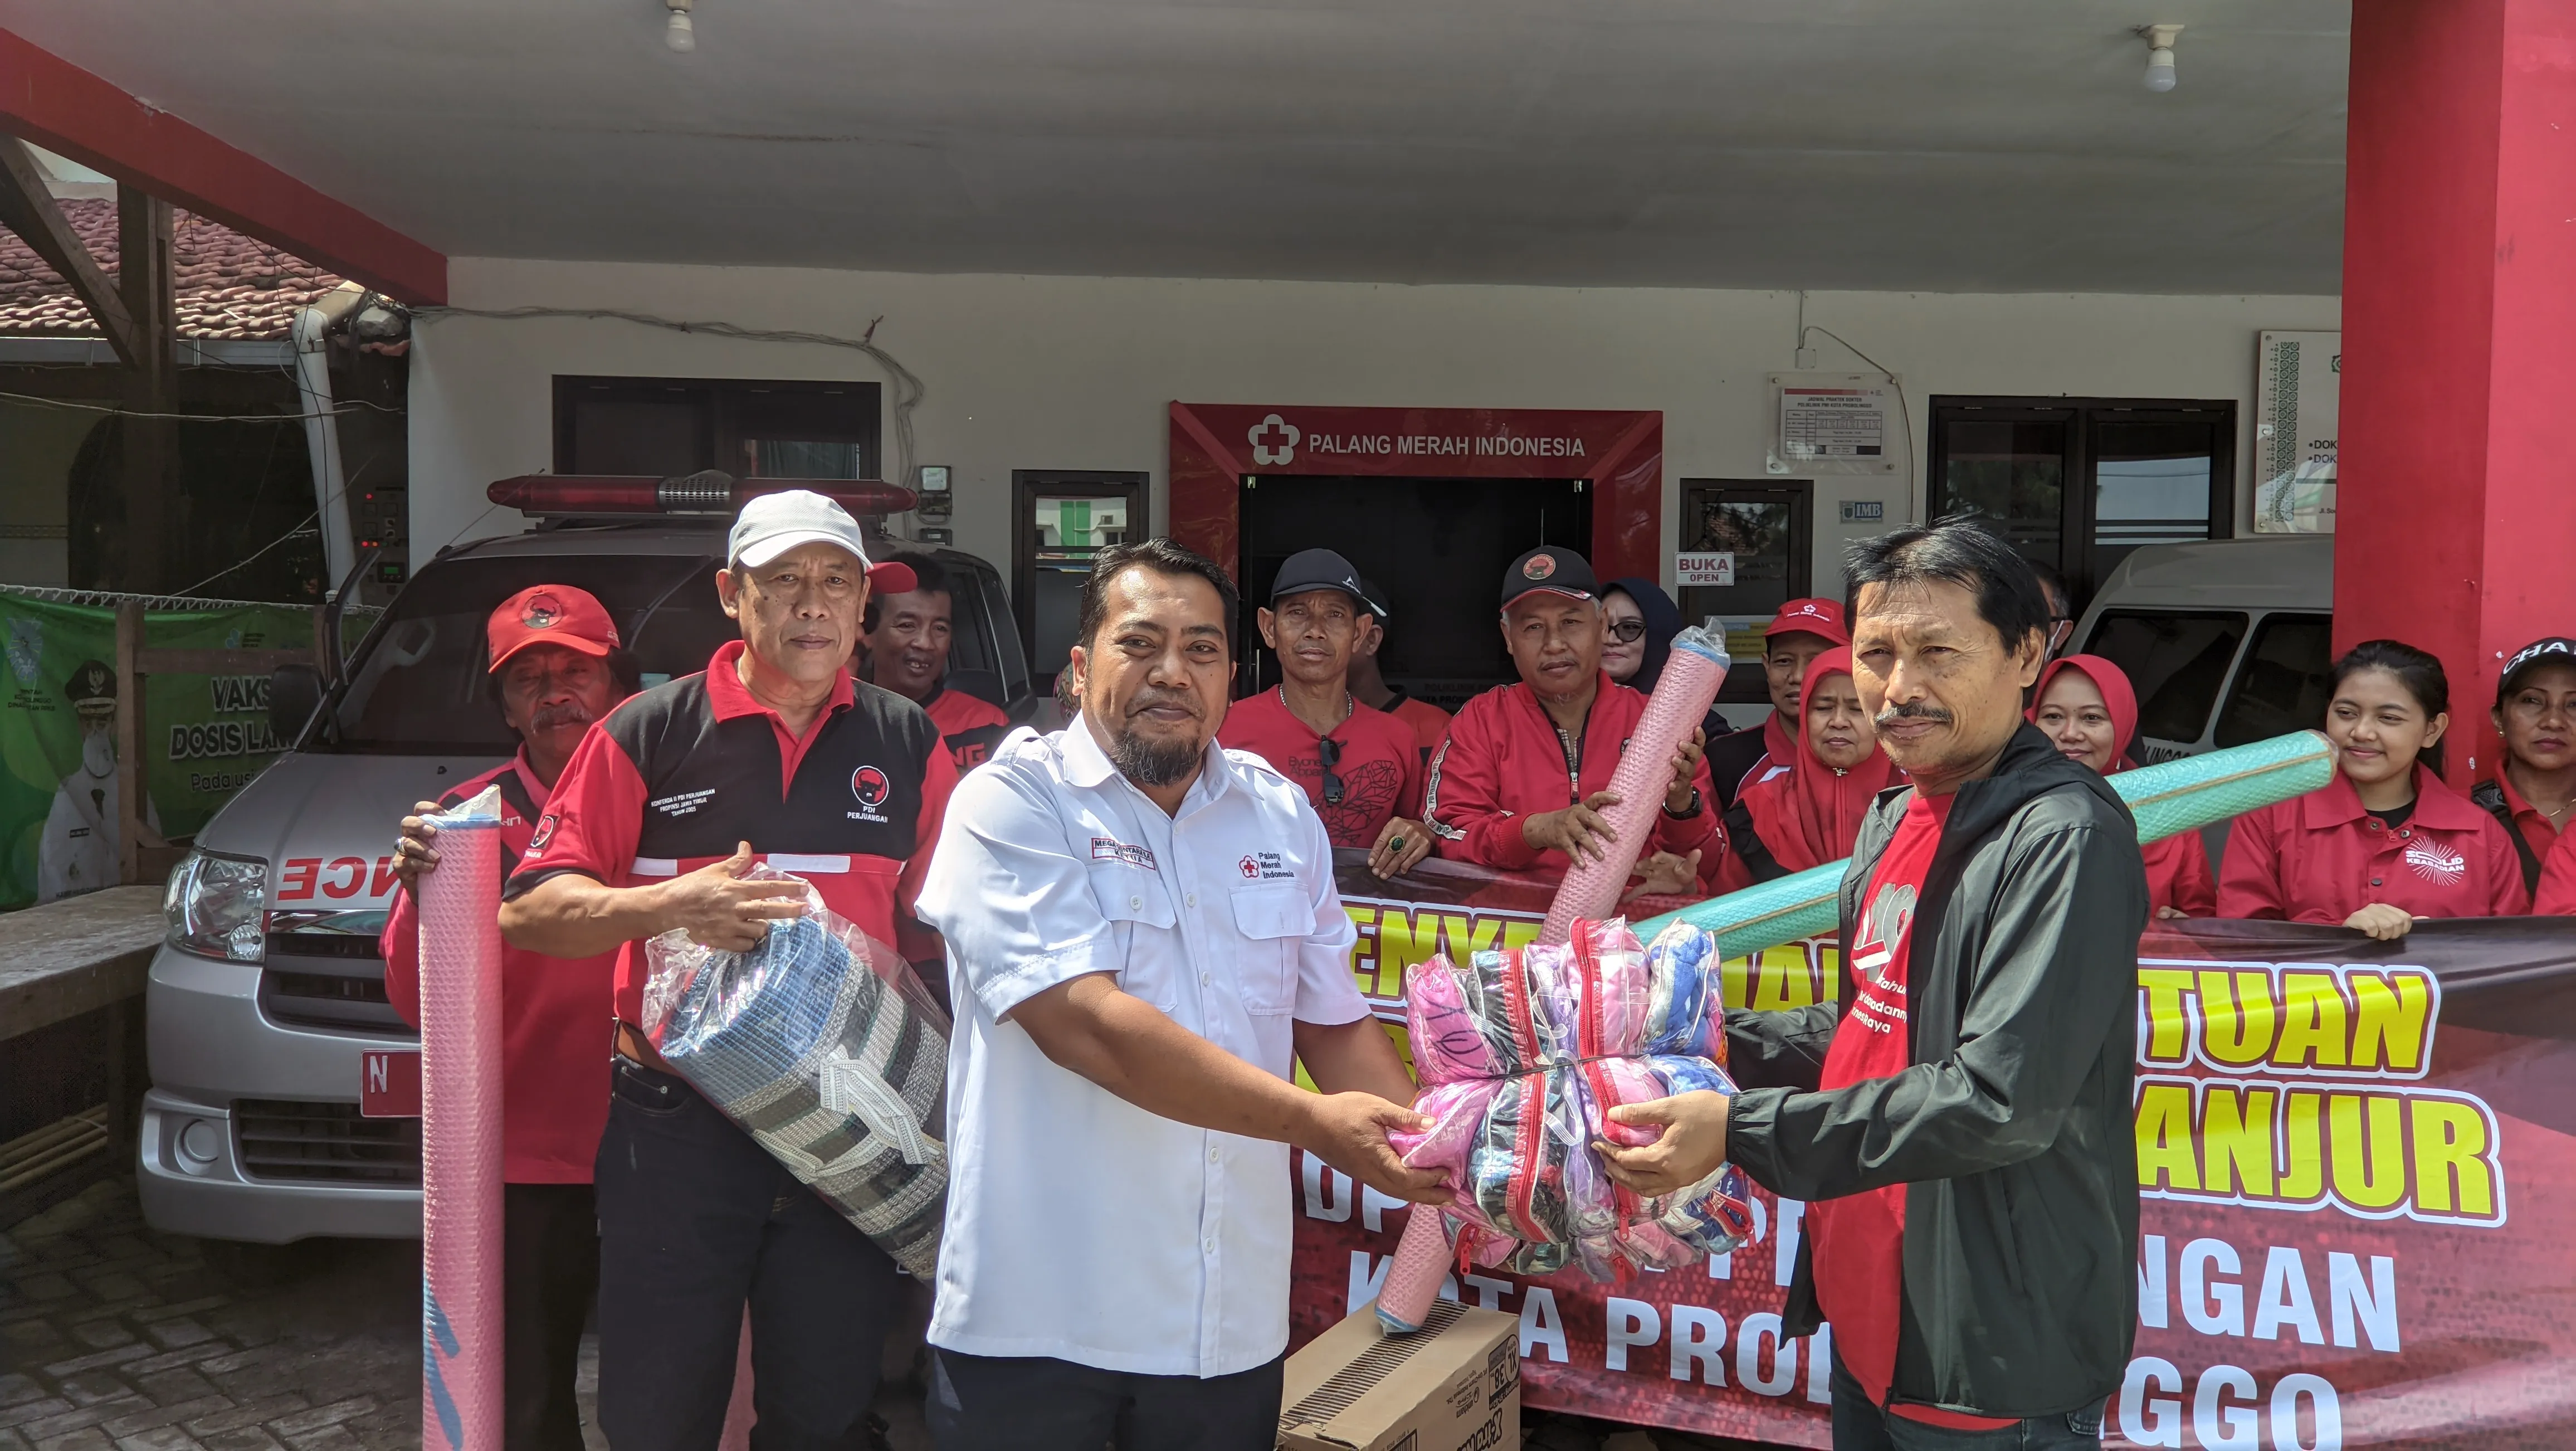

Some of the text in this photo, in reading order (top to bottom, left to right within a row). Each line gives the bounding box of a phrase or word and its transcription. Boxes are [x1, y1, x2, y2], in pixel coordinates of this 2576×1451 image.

[1310, 434, 1585, 457] PALANG MERAH INDONESIA
[2314, 440, 2337, 449] DOK
[2314, 454, 2337, 464] DOK
[1856, 504, 1881, 517] IMB
[1679, 559, 1729, 571] BUKA
[2503, 642, 2576, 675] CHA
[169, 722, 243, 758] DOSIS
[191, 771, 231, 791] Pada
[686, 788, 715, 799] PERJUANGAN
[660, 803, 680, 812] PROPINSI
[671, 809, 685, 817] TAHUN
[847, 811, 888, 823] PERJUANGAN
[1095, 840, 1116, 848] MEGA
[1115, 849, 1143, 863] KETUA
[1258, 851, 1281, 861] Palang
[2406, 850, 2464, 866] SOLID
[1260, 861, 1282, 869] Merah
[2406, 858, 2465, 872] KEABADIAN
[1262, 870, 1295, 879] Indonesia
[2138, 966, 2431, 1072] TUAN
[370, 1055, 388, 1093] N
[2135, 1084, 2493, 1215] ANJUR
[1508, 1347, 1516, 1375] XL
[1495, 1363, 1505, 1390] 38
